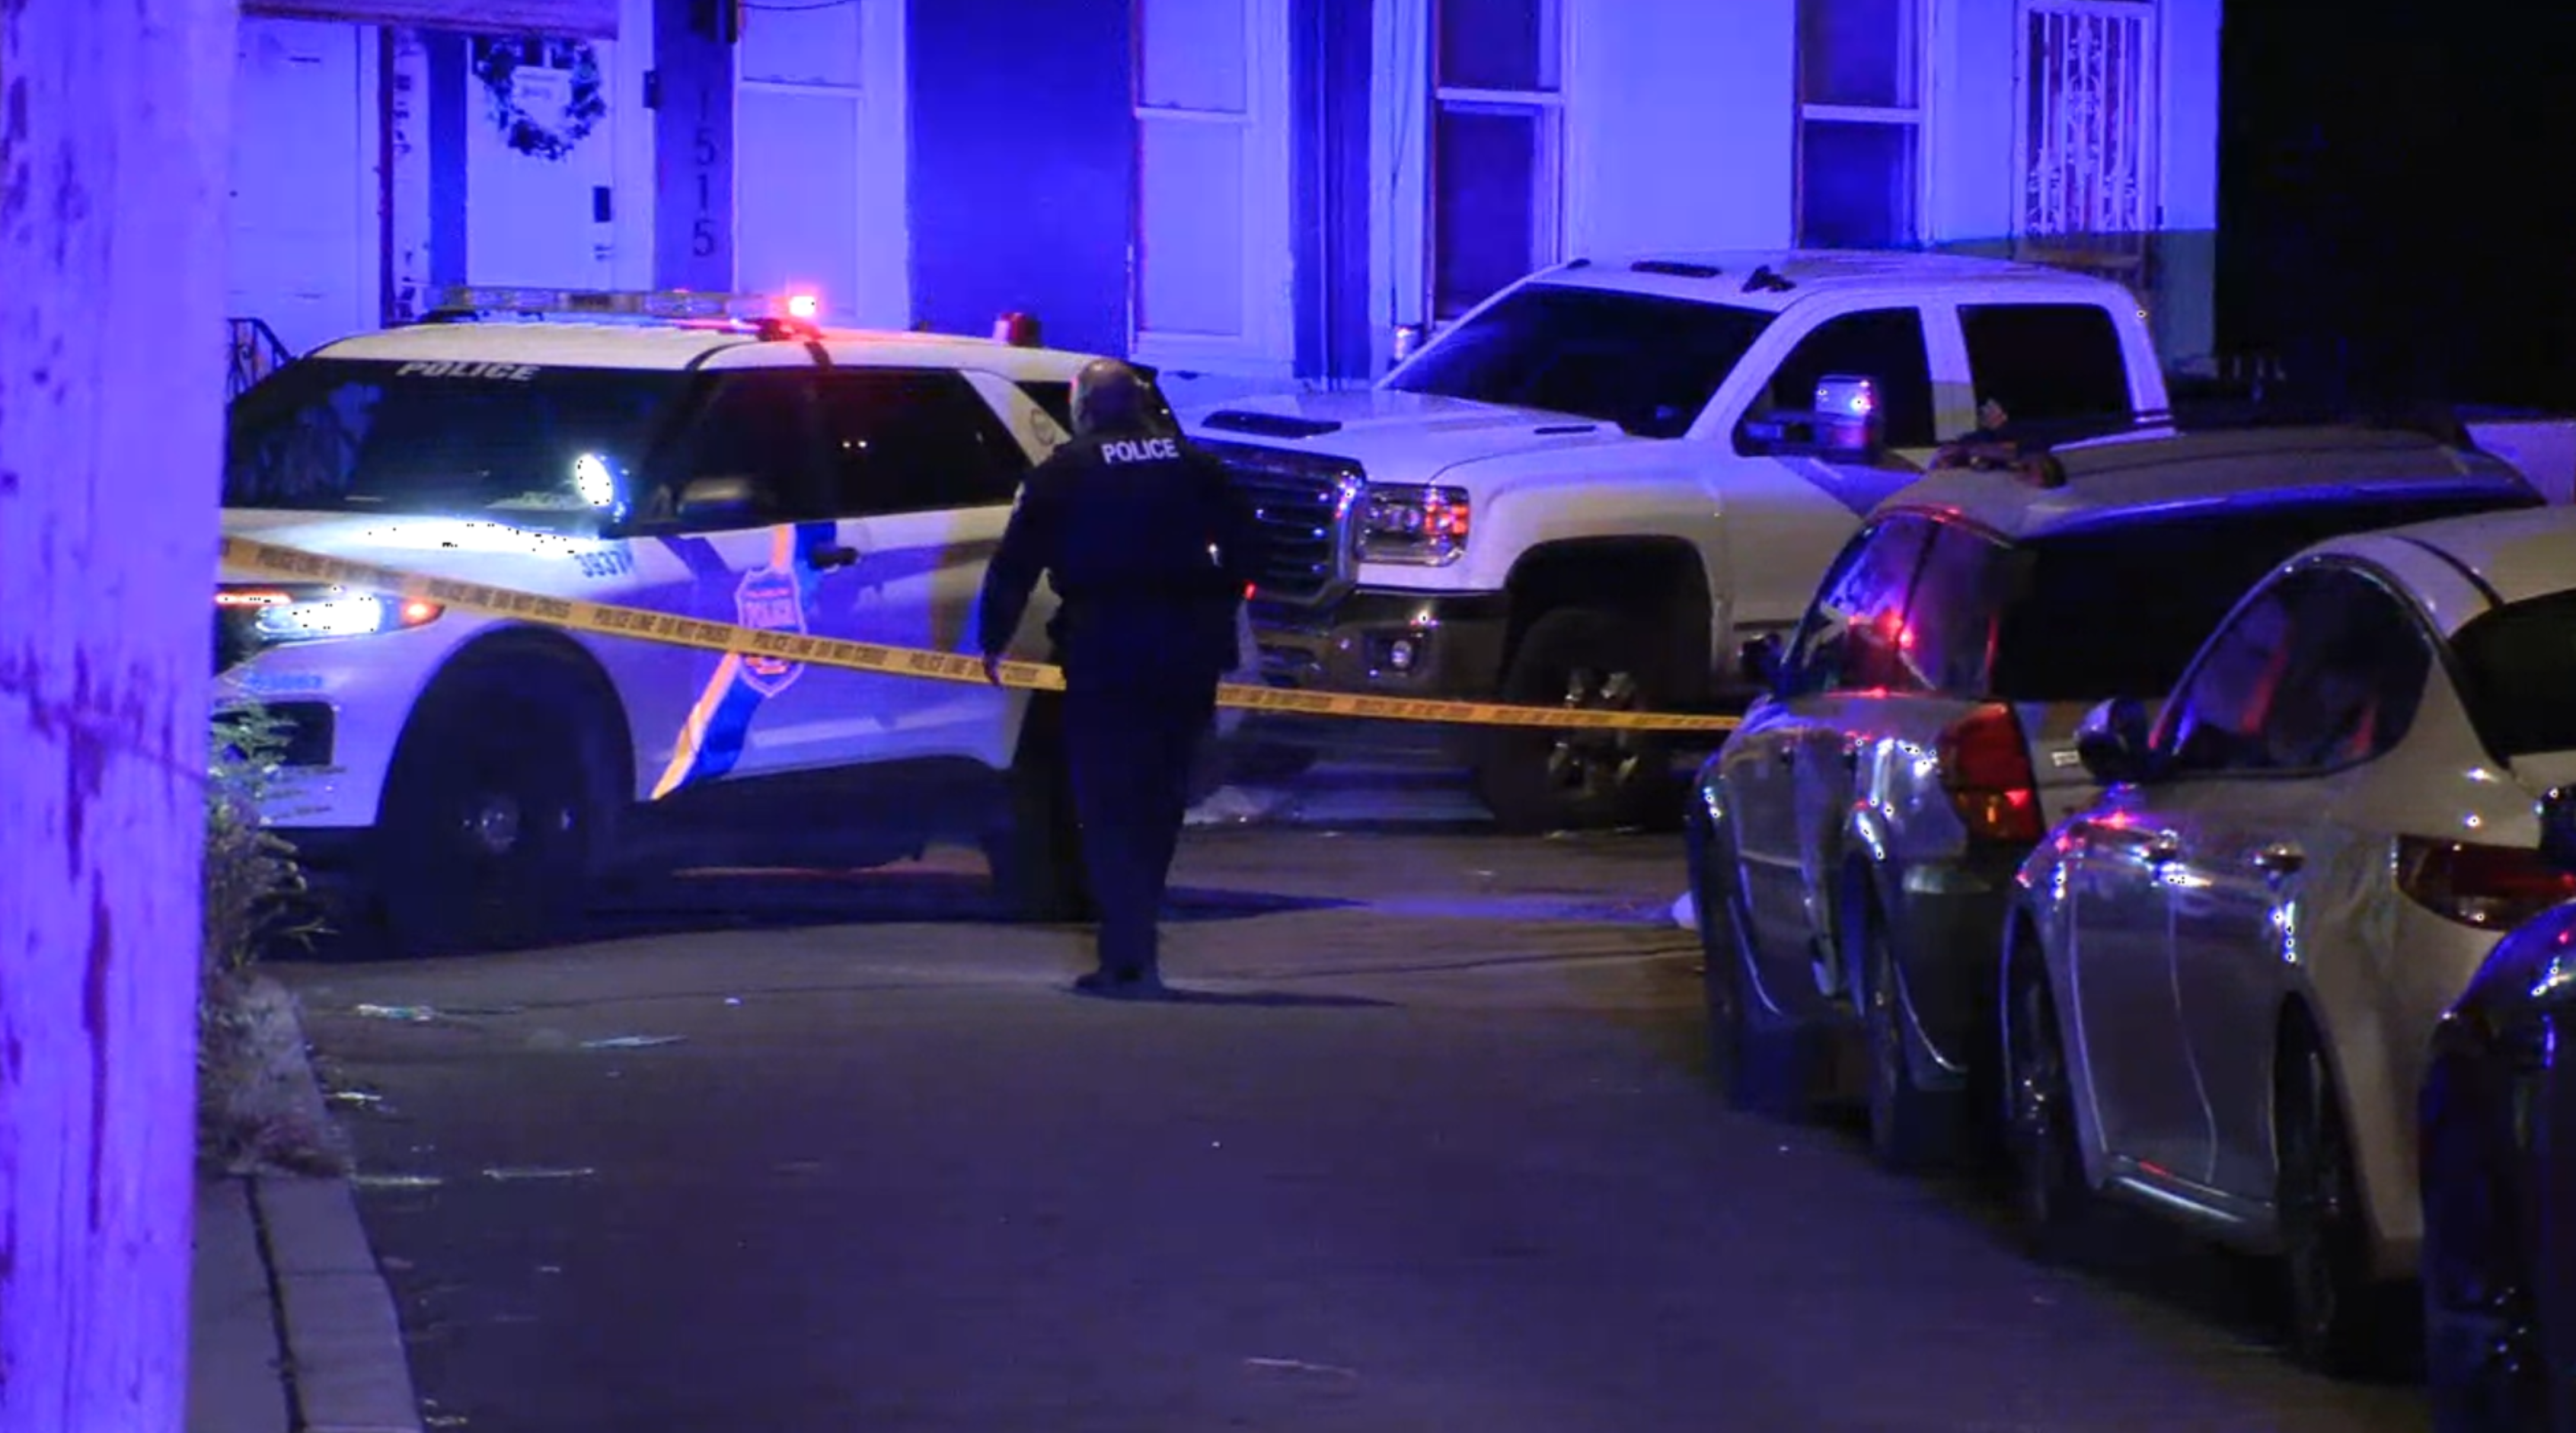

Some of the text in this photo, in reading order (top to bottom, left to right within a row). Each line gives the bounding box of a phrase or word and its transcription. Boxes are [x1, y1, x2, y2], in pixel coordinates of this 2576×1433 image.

[694, 88, 716, 257] 1515
[395, 361, 541, 381] POLICE
[1101, 438, 1179, 464] POLICE
[594, 606, 729, 645] POLICE LINE DO NOT CROSS
[754, 632, 788, 652] POLICE
[788, 637, 812, 655] LINE
[816, 640, 832, 657] DO
[833, 642, 853, 660] NOT
[911, 653, 943, 672] POLICE
